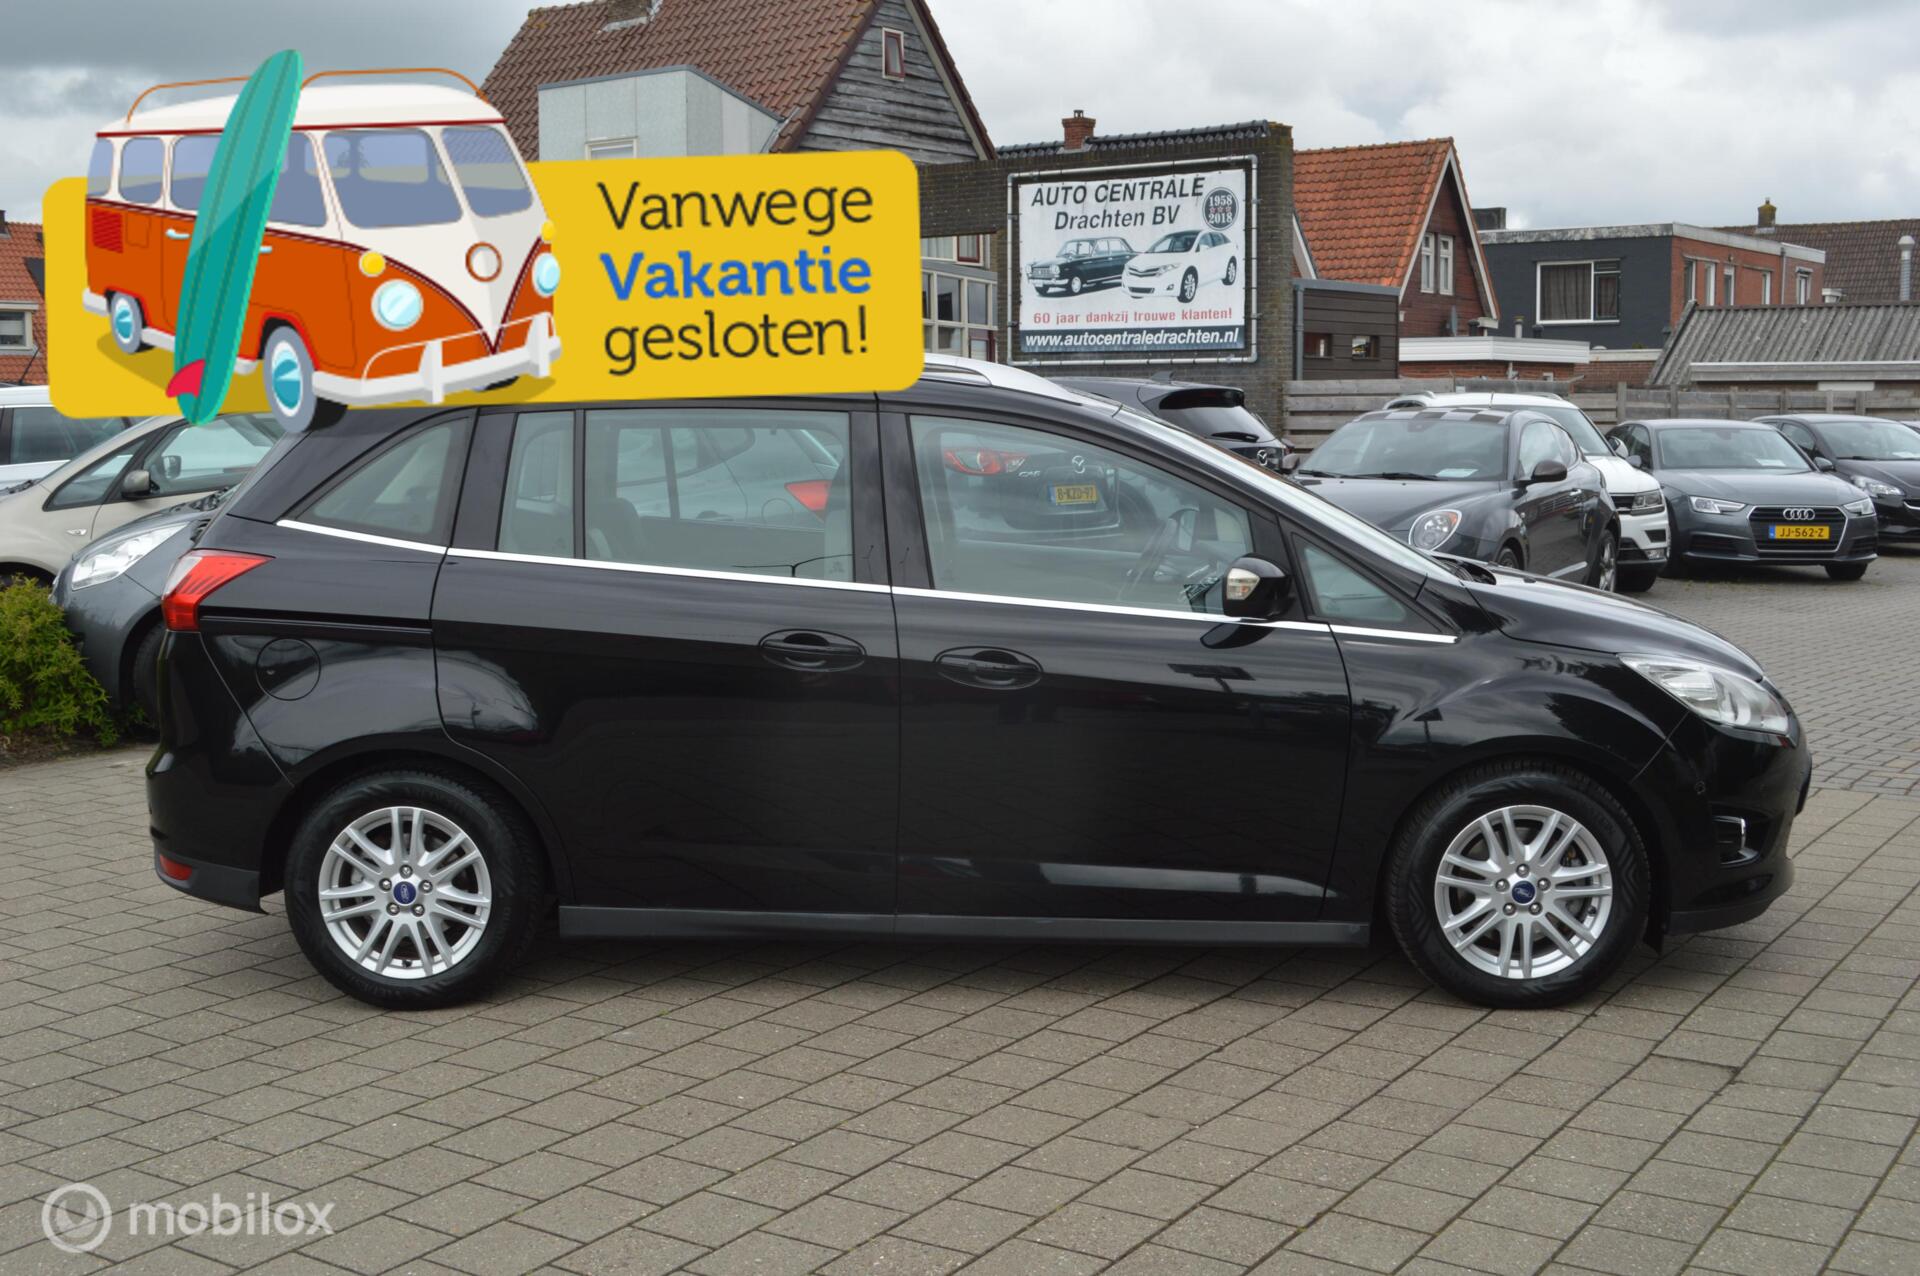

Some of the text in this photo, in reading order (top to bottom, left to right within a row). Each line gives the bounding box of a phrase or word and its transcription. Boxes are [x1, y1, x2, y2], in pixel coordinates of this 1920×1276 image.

[1031, 177, 1205, 207] AUTO CENTRALE
[1208, 194, 1233, 207] 1958
[1054, 204, 1180, 230] Drachten BV
[1208, 212, 1233, 224] 2018
[1033, 307, 1232, 325] 60 jaar dankzij trouwe klanten!
[1025, 327, 1239, 346] www.autocentraledrachten.nl
[1779, 527, 1824, 538] JJ-562-Z
